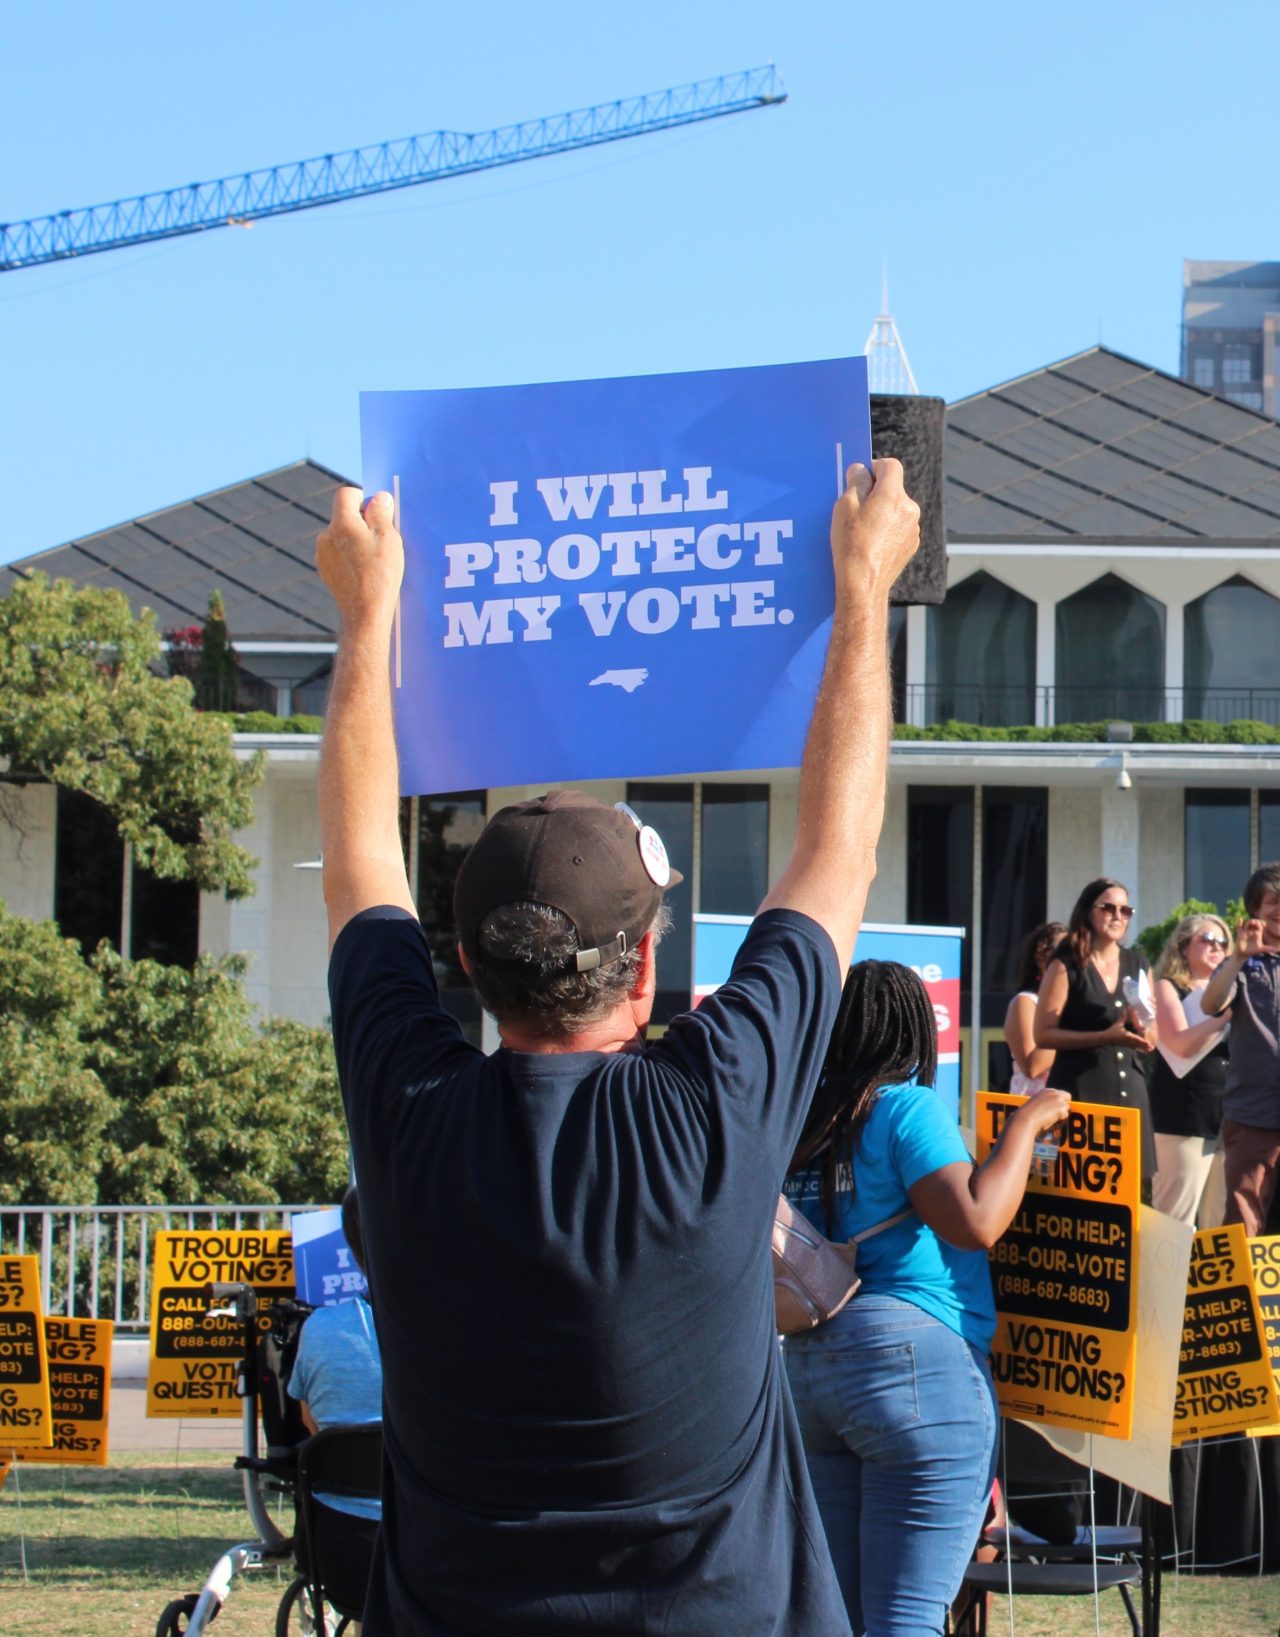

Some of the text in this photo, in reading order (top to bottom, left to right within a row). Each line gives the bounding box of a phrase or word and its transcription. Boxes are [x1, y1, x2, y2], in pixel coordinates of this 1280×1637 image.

[489, 466, 729, 527] I WILL
[443, 519, 794, 589] PROTECT
[443, 580, 795, 649] MY VOTE.
[1036, 1214, 1073, 1238] FOR
[1077, 1219, 1126, 1247] HELP:
[166, 1237, 292, 1258] TROUBLE
[336, 1248, 350, 1268] I
[169, 1260, 292, 1282] VOTING?
[162, 1297, 206, 1312] CALL
[998, 1275, 1110, 1313] (888-687-8683)
[1200, 1299, 1248, 1320] HELP:
[1008, 1321, 1102, 1366] VOTING
[51, 1373, 98, 1385] HELP:
[183, 1363, 238, 1380] VOTI
[1176, 1371, 1241, 1400] OTING
[1173, 1386, 1269, 1420] STIONS?
